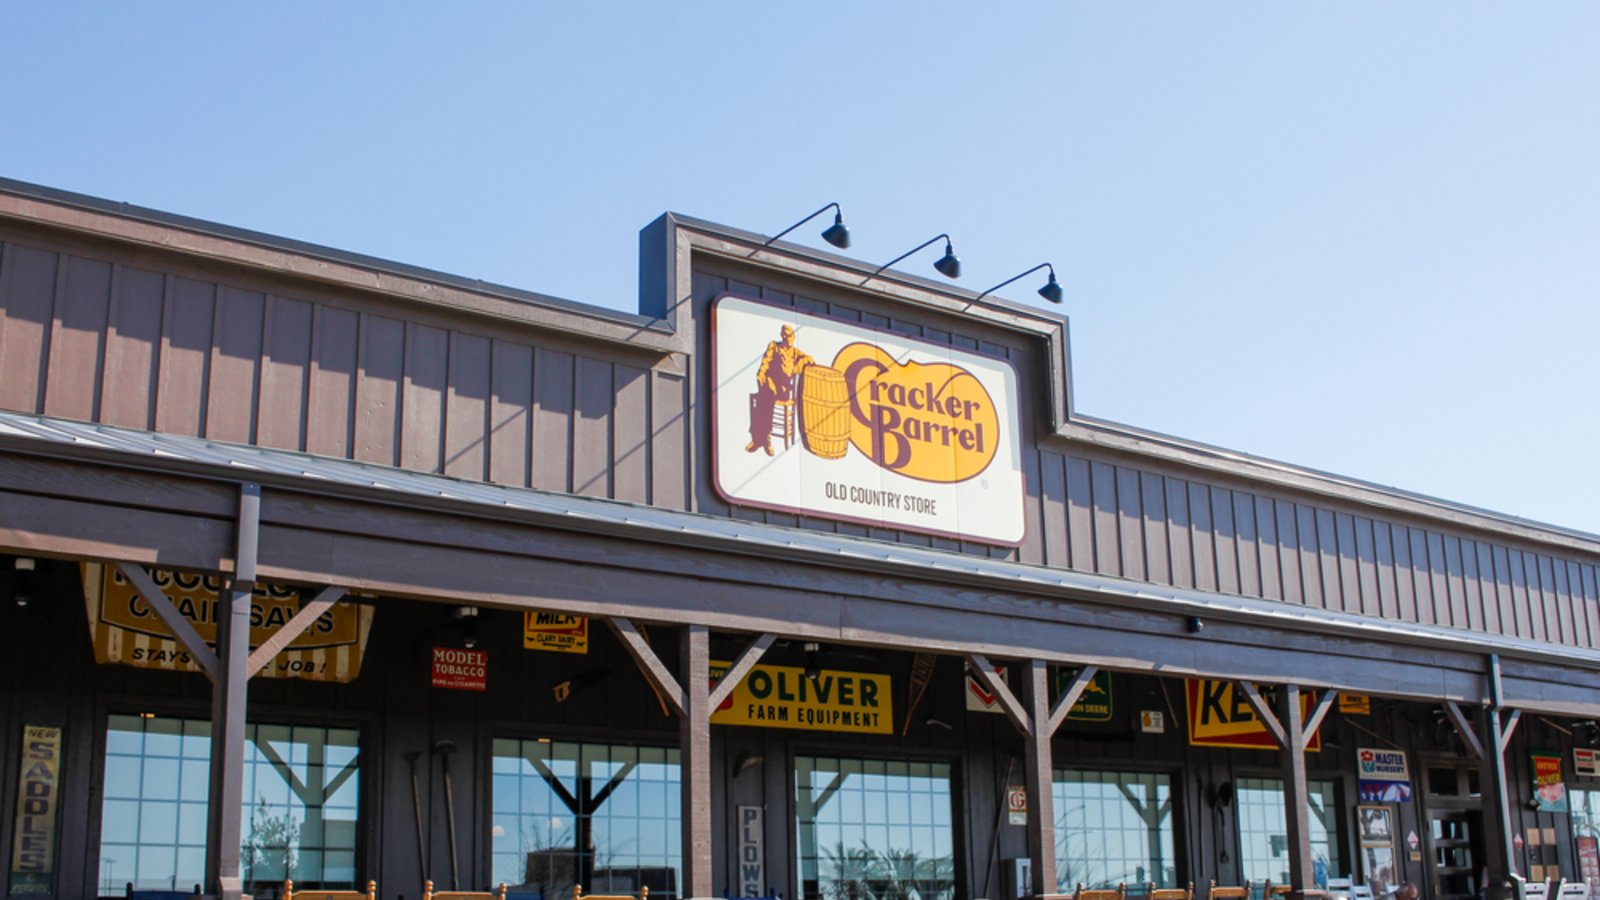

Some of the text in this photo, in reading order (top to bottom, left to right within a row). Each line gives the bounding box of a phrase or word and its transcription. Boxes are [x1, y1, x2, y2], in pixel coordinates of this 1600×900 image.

[845, 358, 980, 429] Cracker
[869, 403, 984, 469] Barrel
[825, 481, 937, 516] OLD COUNTRY STORE
[536, 612, 576, 625] MILK
[433, 649, 486, 666] MODEL
[435, 663, 485, 677] TOBACCO
[747, 669, 879, 707] OLIVER
[748, 704, 879, 727] FARM EQUIPMENT
[28, 729, 58, 739] NEW
[1376, 753, 1403, 765] MASTER
[1376, 765, 1404, 774] NURSERY
[19, 742, 54, 871] SADDLES
[742, 809, 760, 897] PLOWS
